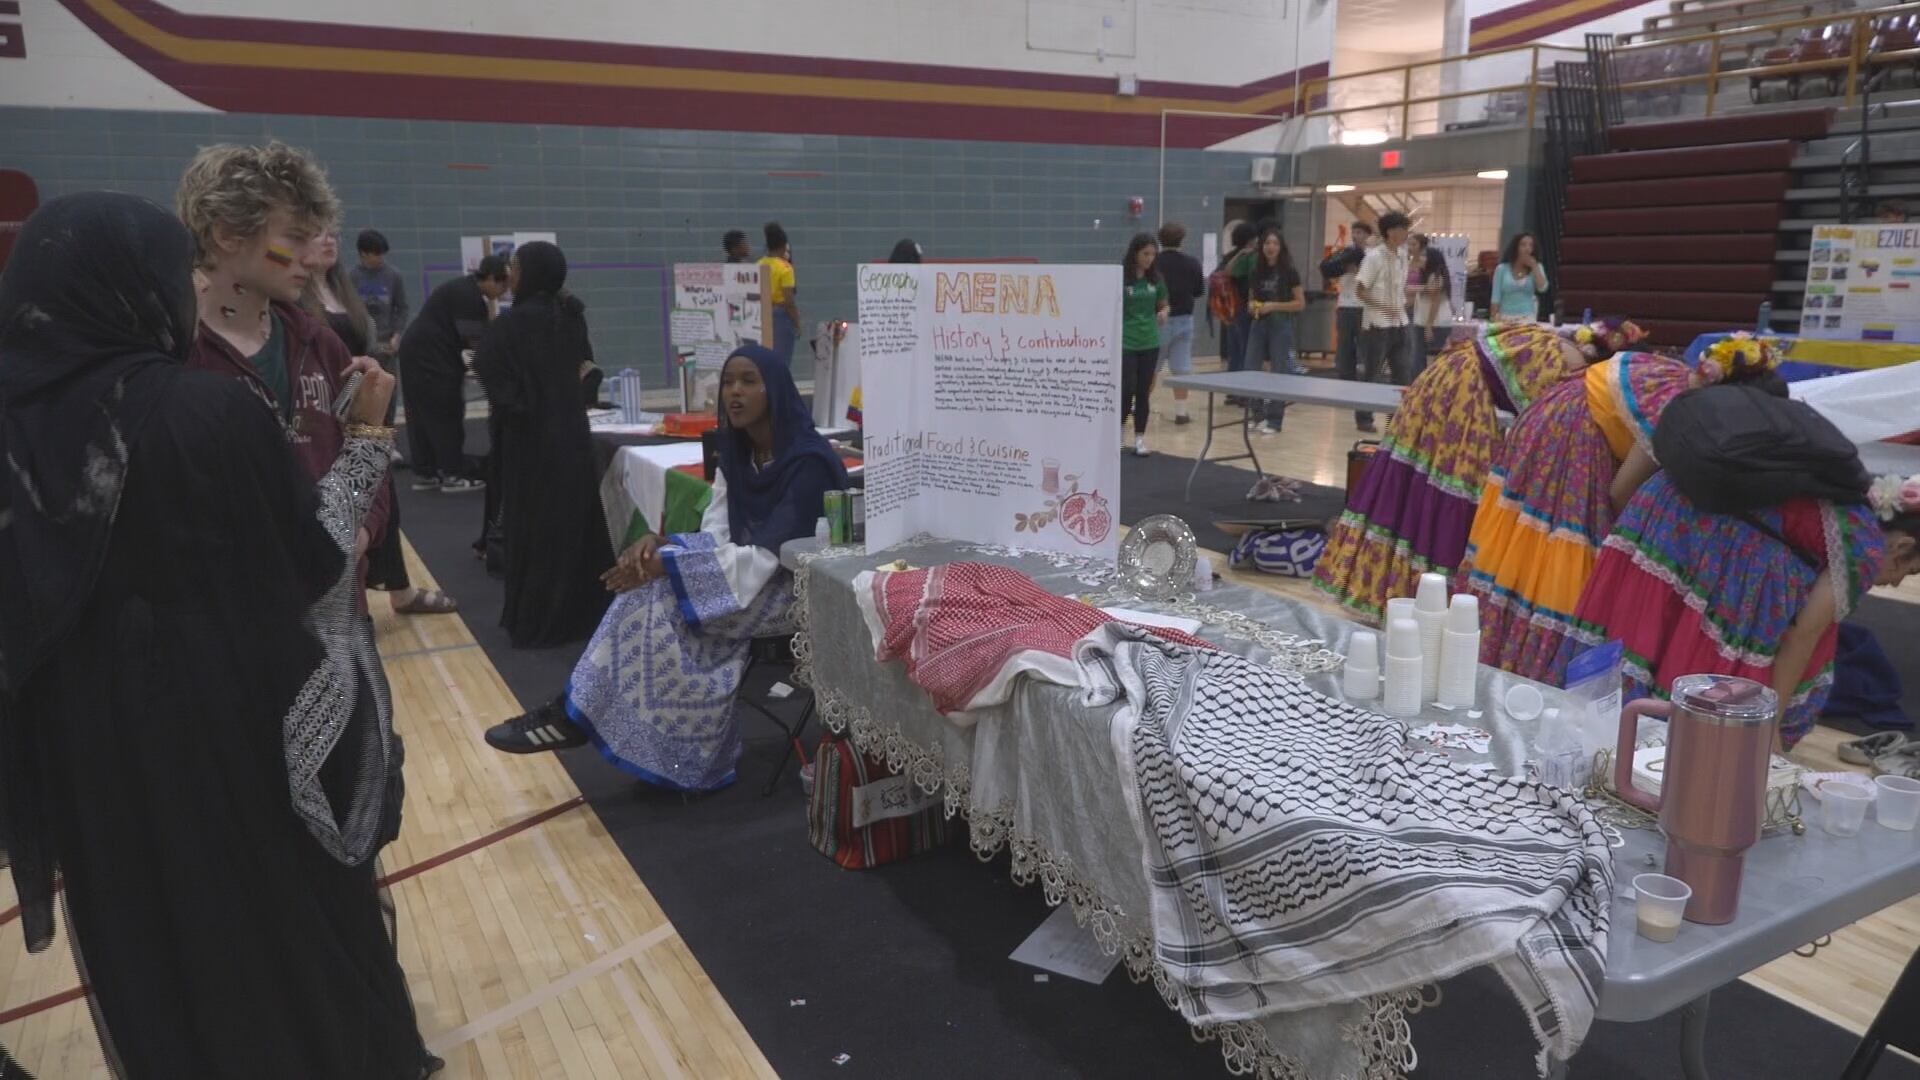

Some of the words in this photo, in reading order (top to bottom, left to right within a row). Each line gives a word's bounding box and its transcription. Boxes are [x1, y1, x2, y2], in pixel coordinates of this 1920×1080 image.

[860, 265, 918, 300] Geography
[935, 271, 1061, 318] MENA
[933, 325, 993, 360] History
[1017, 328, 1106, 350] contributions
[927, 432, 964, 454] Food
[978, 440, 1029, 461] Cuisine
